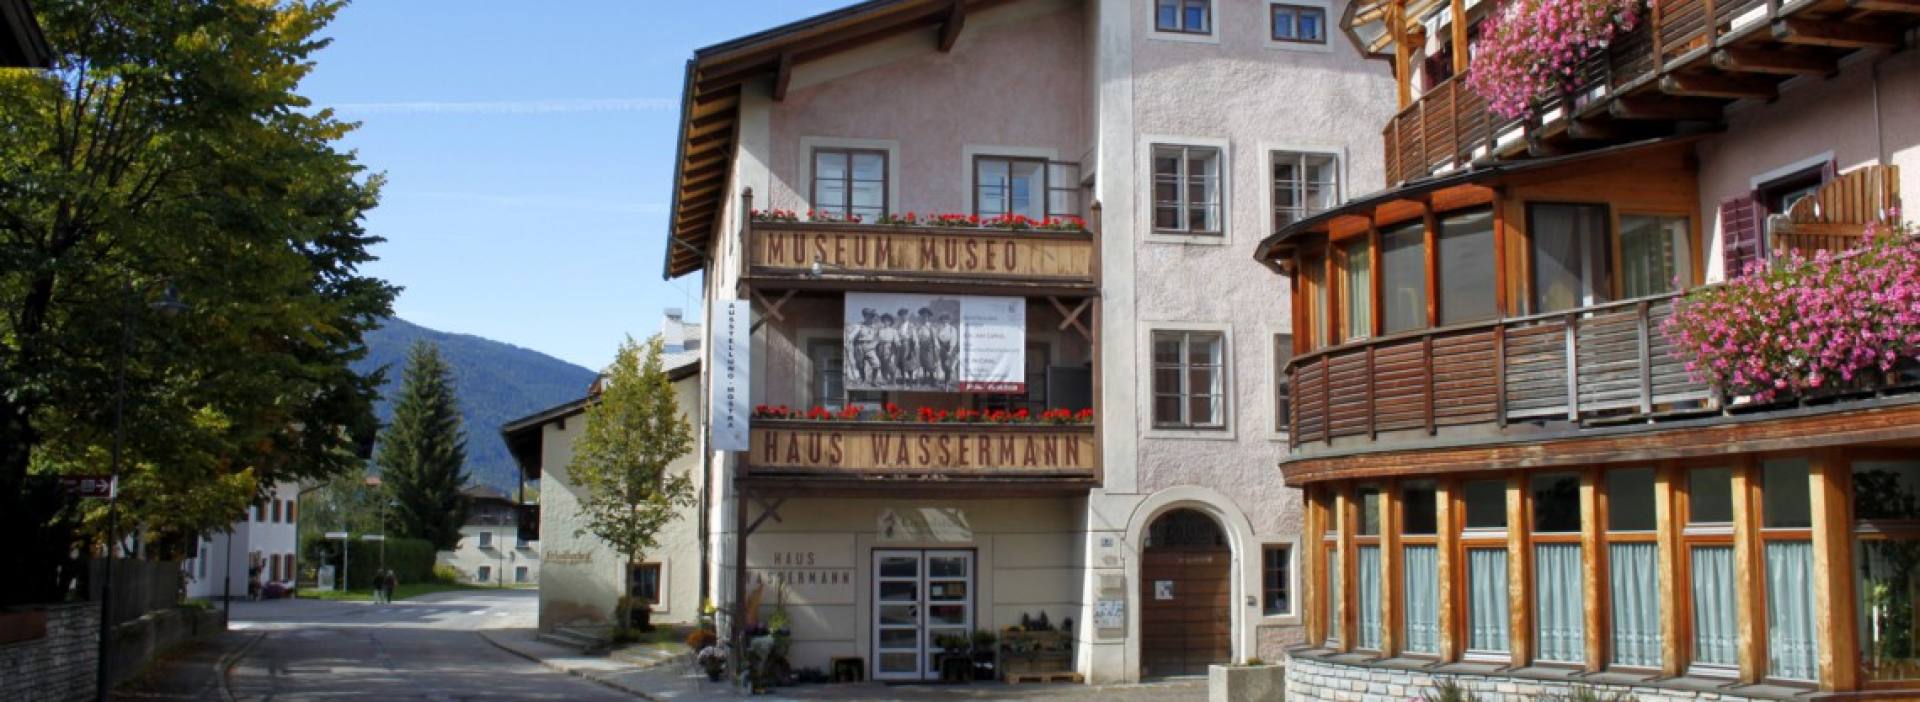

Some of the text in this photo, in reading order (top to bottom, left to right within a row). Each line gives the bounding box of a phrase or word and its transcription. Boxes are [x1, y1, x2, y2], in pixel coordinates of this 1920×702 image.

[767, 231, 1017, 271] MUSEUM MUSEO
[727, 303, 736, 379] AUSSTELLUNG
[727, 387, 736, 428] MOSTRA
[764, 430, 1079, 467] HAUS WASSERMANN
[774, 551, 815, 565] HAUS
